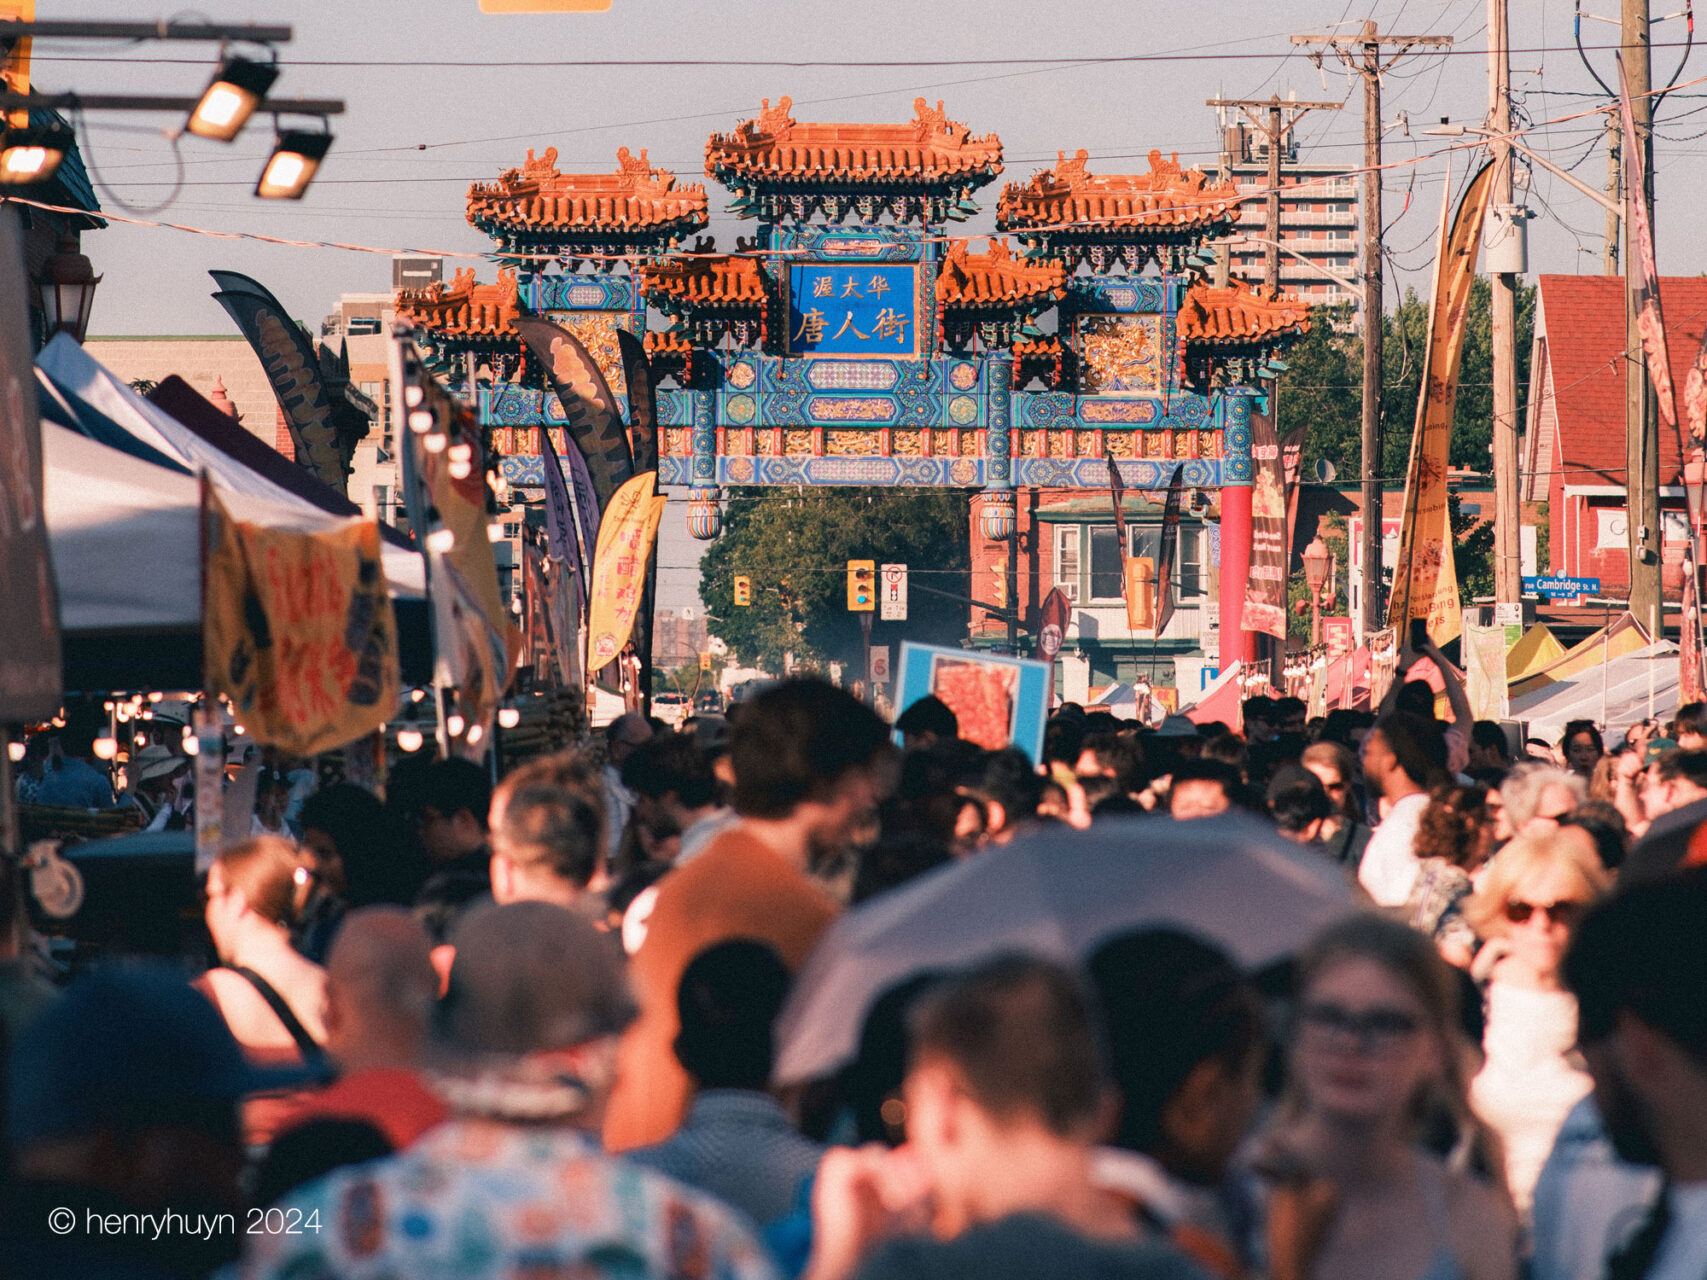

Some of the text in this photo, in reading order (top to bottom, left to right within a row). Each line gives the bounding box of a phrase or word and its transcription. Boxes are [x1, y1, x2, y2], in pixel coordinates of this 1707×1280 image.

[813, 275, 892, 301] 渥太华
[792, 307, 911, 345] 唐人街
[1536, 579, 1581, 593] Cambridge
[1582, 583, 1590, 591] St.
[1591, 583, 1599, 591] N.
